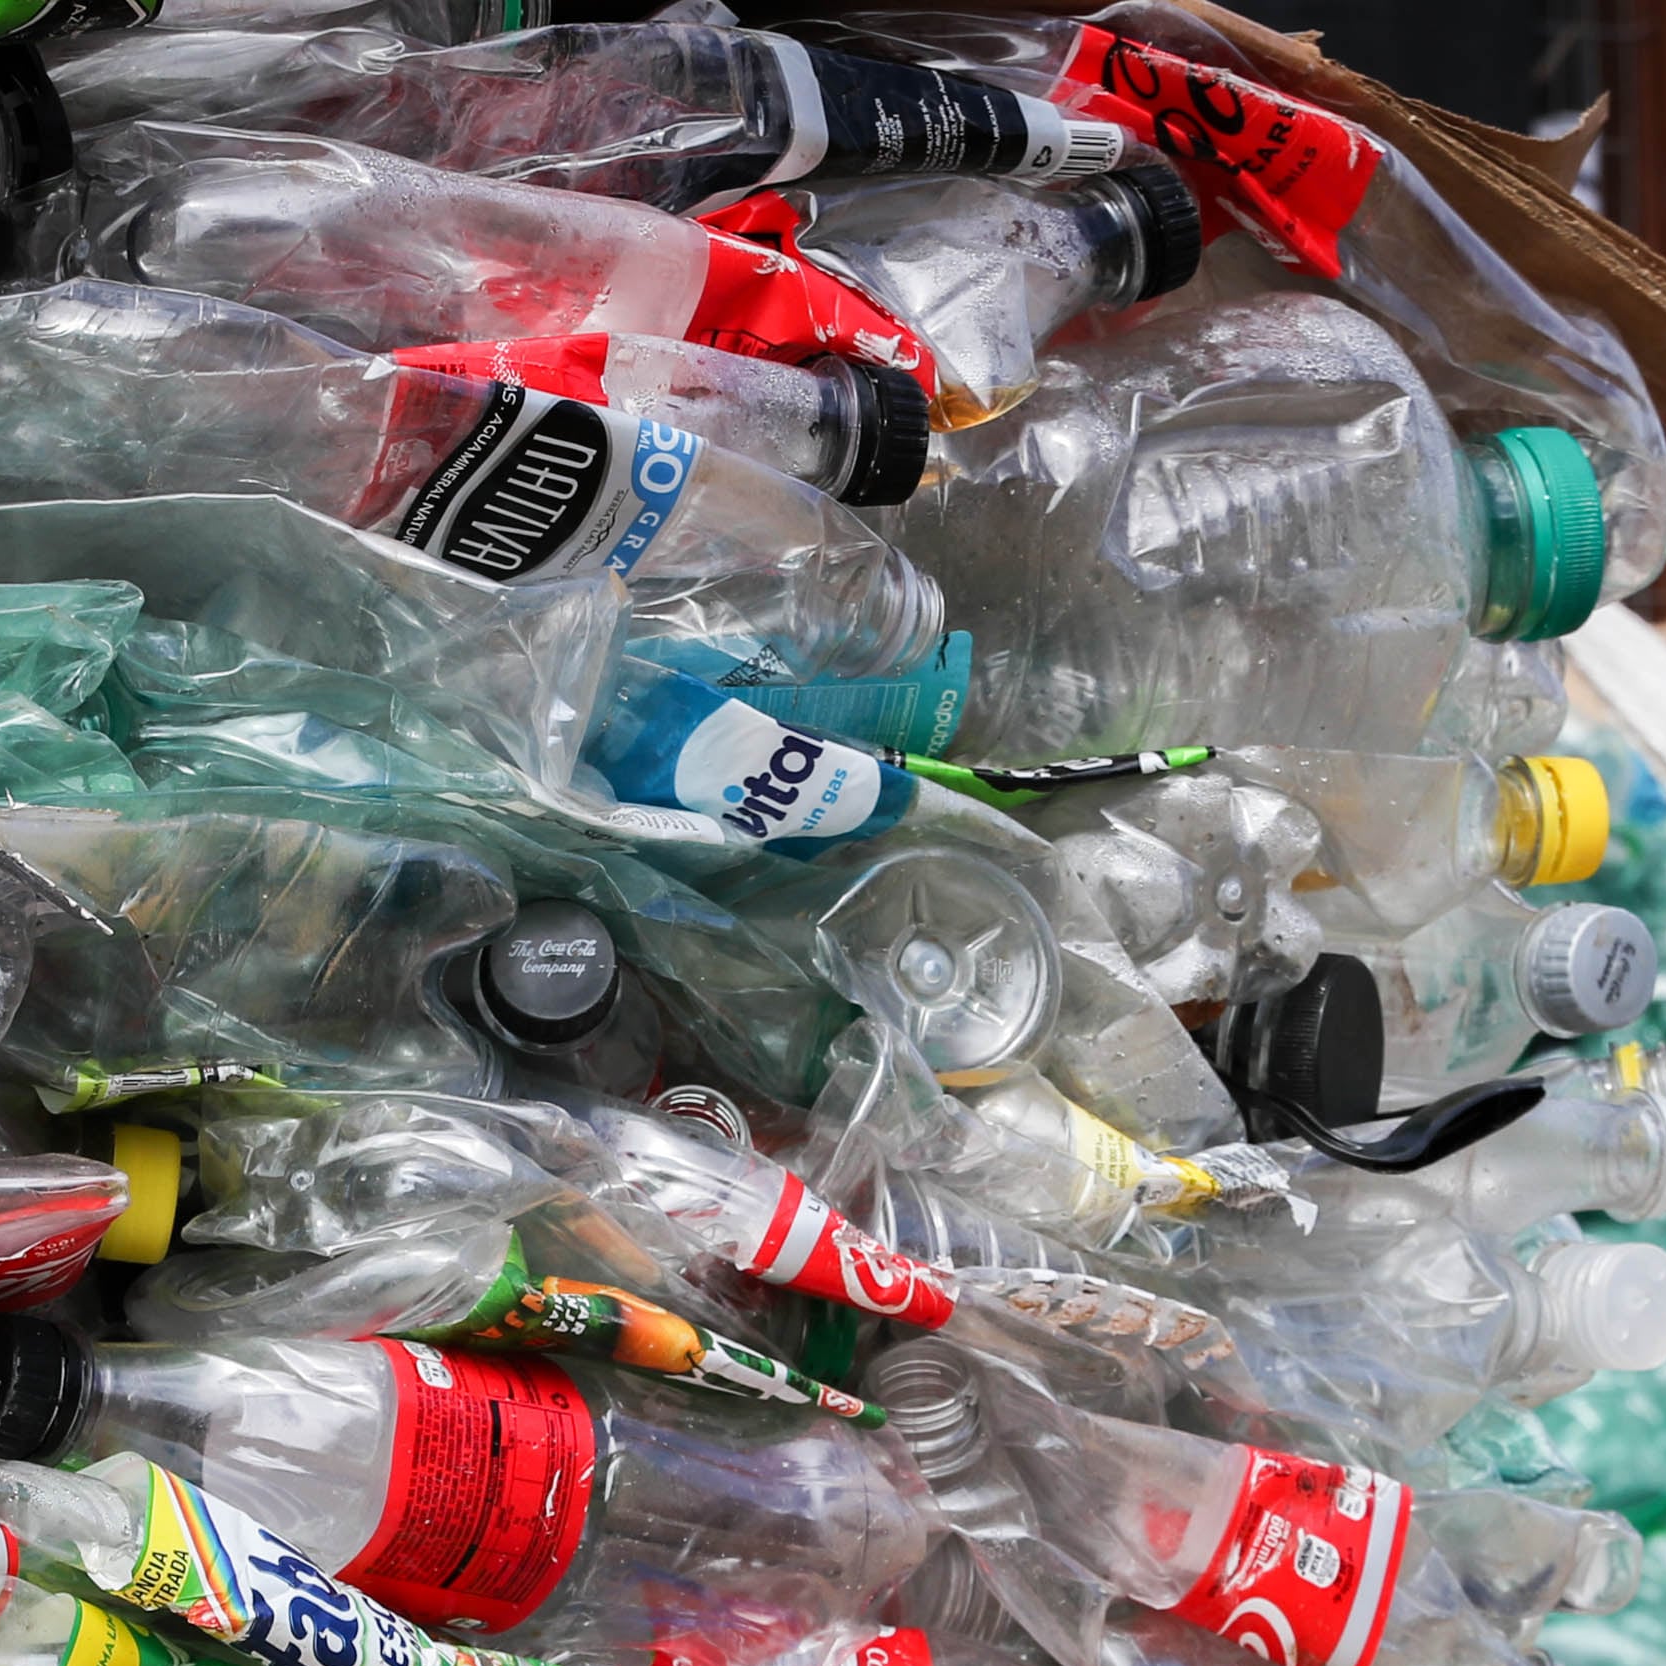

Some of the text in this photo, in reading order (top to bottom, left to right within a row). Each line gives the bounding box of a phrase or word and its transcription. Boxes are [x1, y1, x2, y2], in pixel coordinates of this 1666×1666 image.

[467, 413, 503, 457] AGUA
[635, 429, 651, 453] ML
[425, 449, 472, 502] MINERAL
[449, 432, 598, 571] NATIVA
[821, 767, 849, 804] gas
[509, 939, 536, 957] The
[521, 956, 587, 978] Company
[1263, 1513, 1285, 1549] 600
